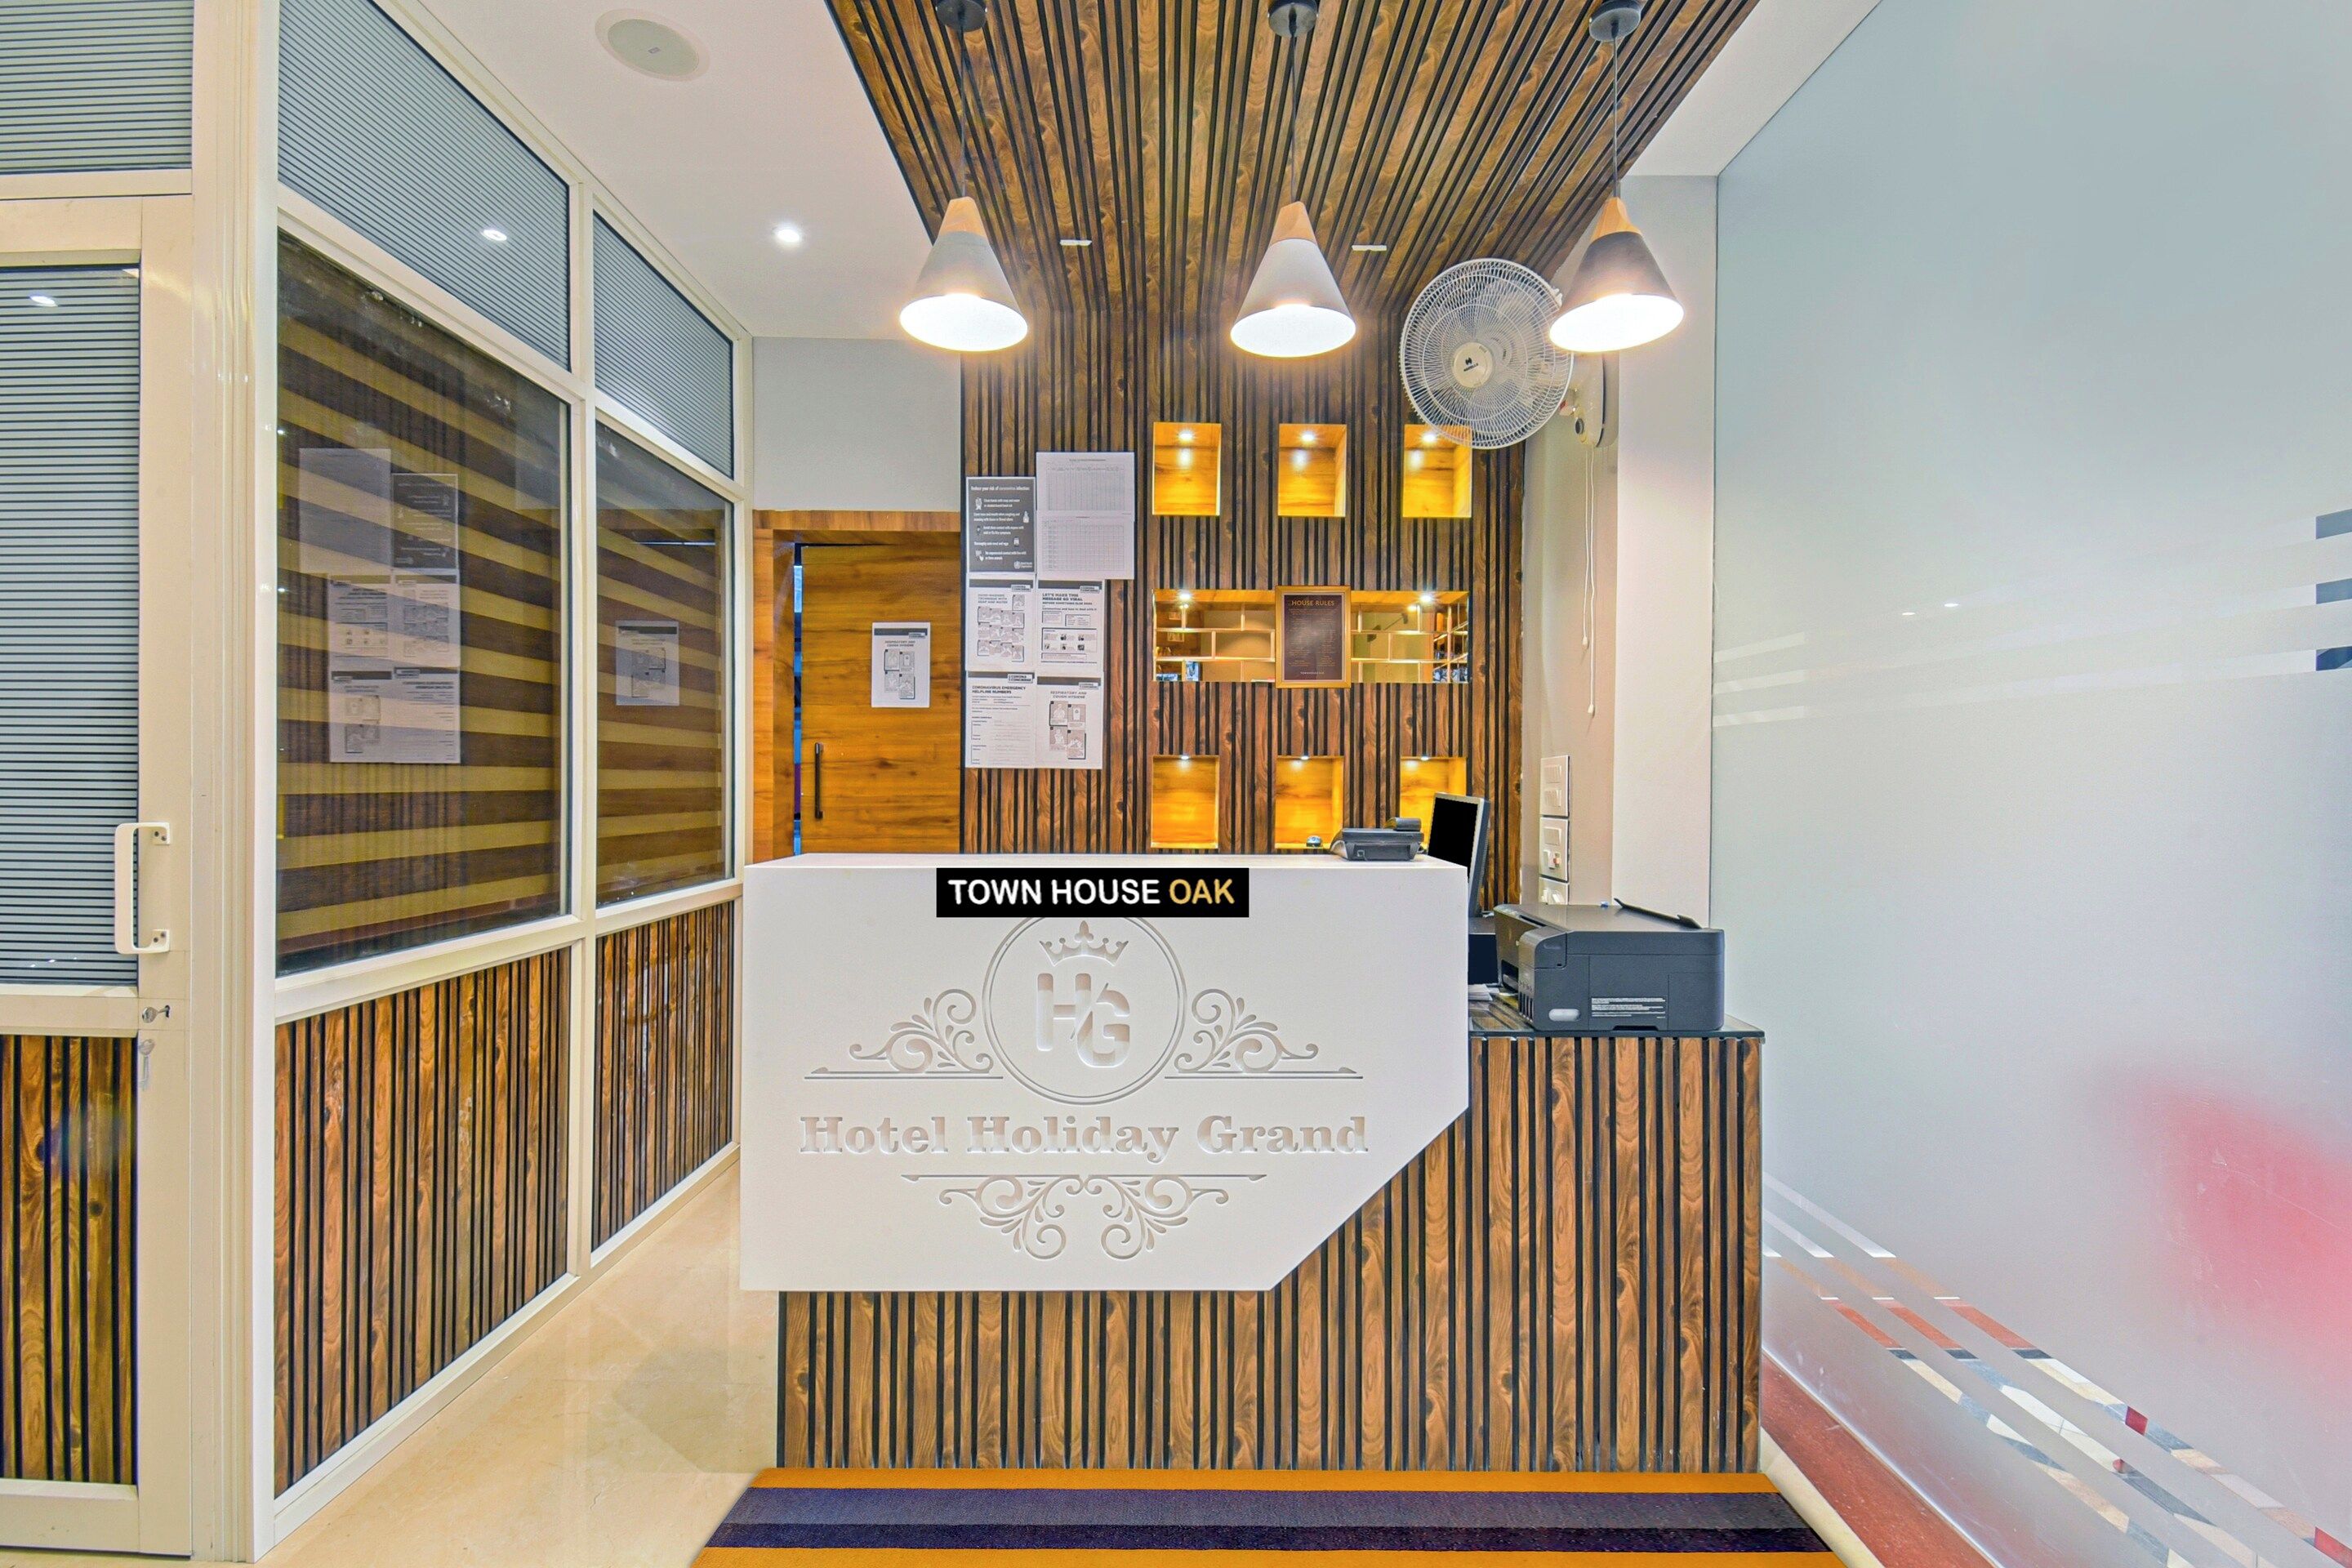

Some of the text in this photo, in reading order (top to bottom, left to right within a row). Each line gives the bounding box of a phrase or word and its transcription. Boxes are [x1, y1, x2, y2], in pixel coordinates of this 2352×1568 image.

[800, 1115, 1369, 1165] Hotel Holiday Grand
